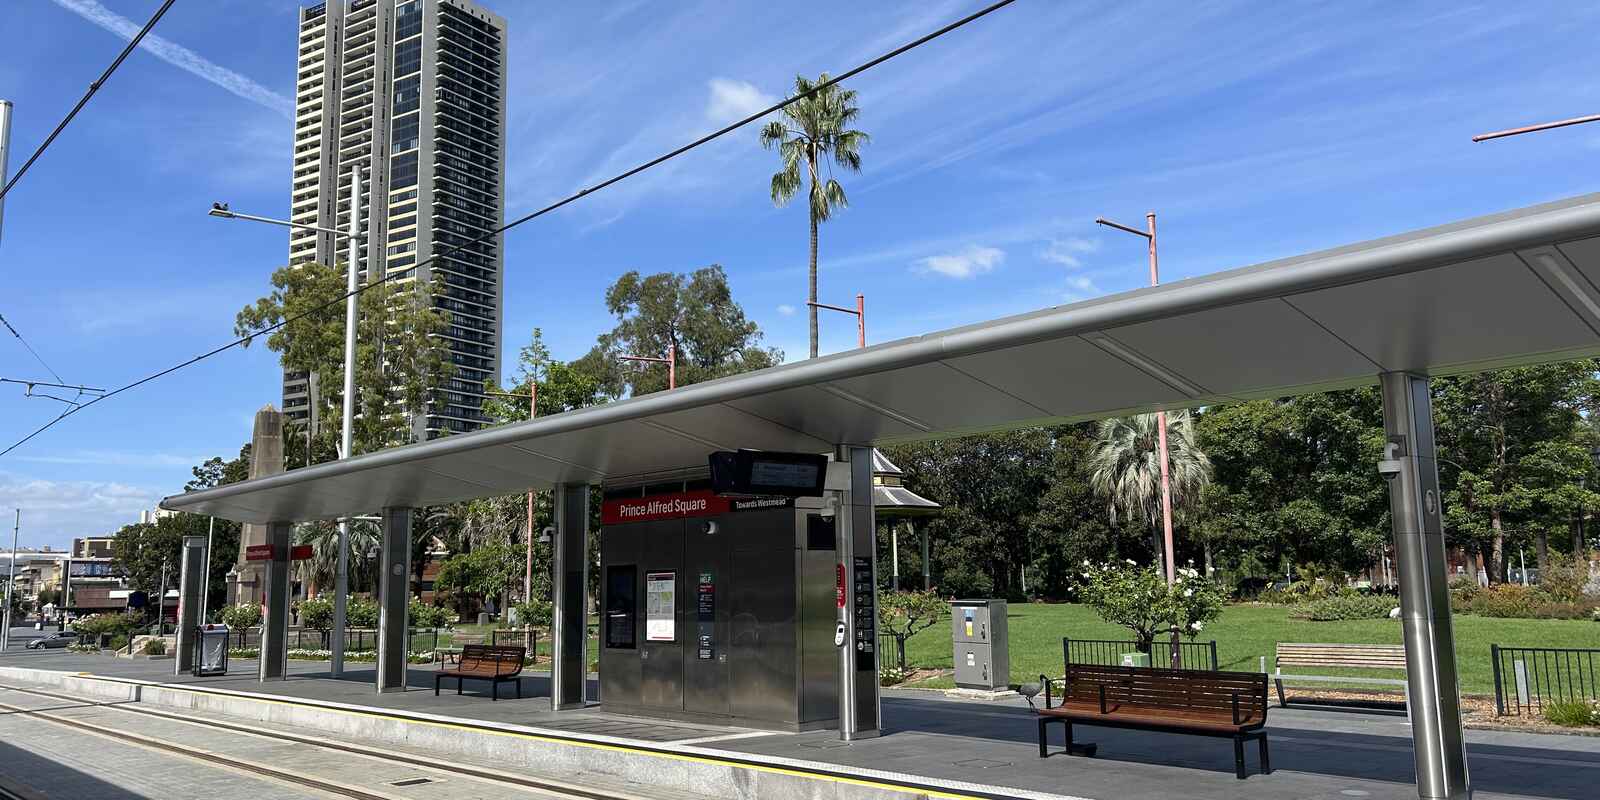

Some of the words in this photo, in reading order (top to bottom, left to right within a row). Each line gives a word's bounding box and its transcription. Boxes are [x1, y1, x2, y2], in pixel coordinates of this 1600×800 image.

[620, 504, 646, 517] Prince
[647, 499, 673, 515] Alfred
[675, 498, 707, 515] Square
[736, 500, 757, 509] Towards
[758, 498, 786, 507] Westmead
